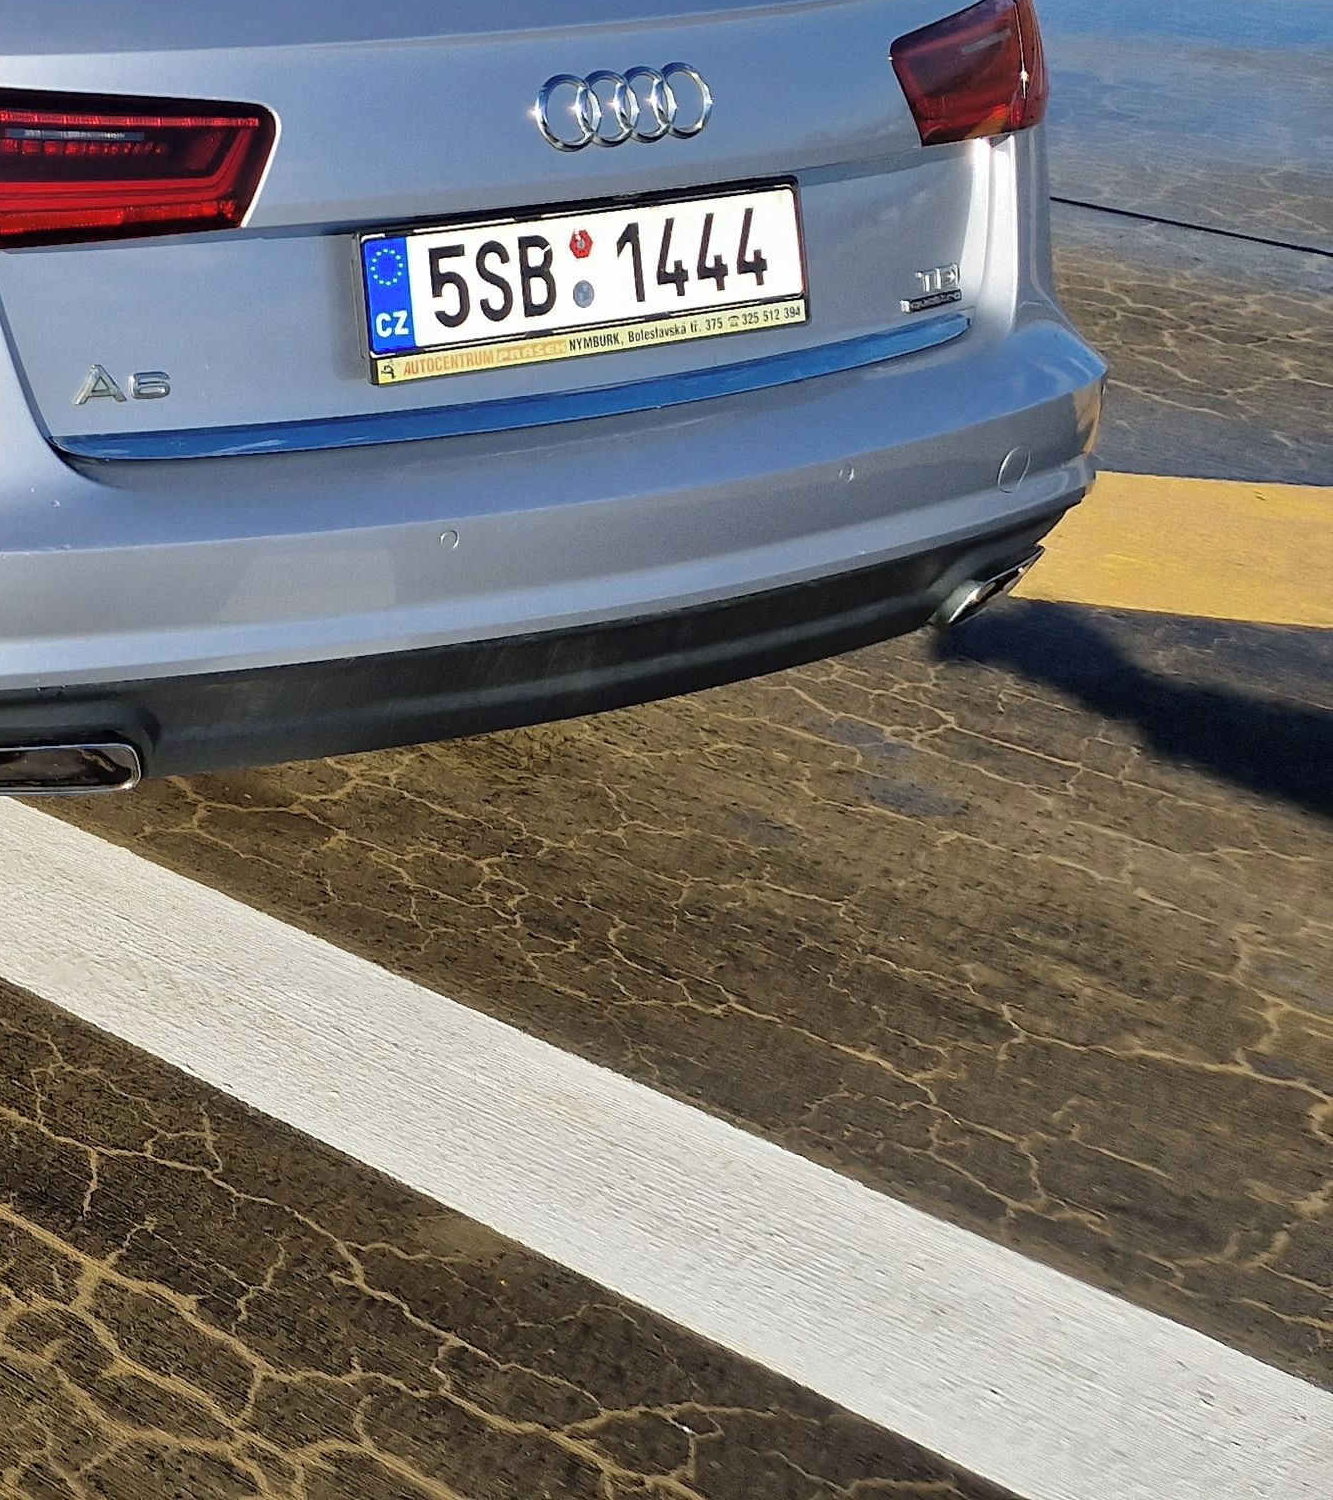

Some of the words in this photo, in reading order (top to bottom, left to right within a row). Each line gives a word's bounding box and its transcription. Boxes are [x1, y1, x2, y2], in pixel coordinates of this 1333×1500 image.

[428, 235, 557, 328] 5SB
[616, 207, 768, 303] 1444
[375, 310, 409, 338] CZ
[403, 350, 494, 376] AUTOCENTRUM
[569, 332, 624, 352] NYMBURK,
[628, 322, 687, 343] Boleslavská
[705, 316, 724, 331] 375
[741, 312, 760, 326] 325
[763, 308, 780, 323] 512
[784, 305, 802, 319] 394
[73, 364, 171, 405] A6
